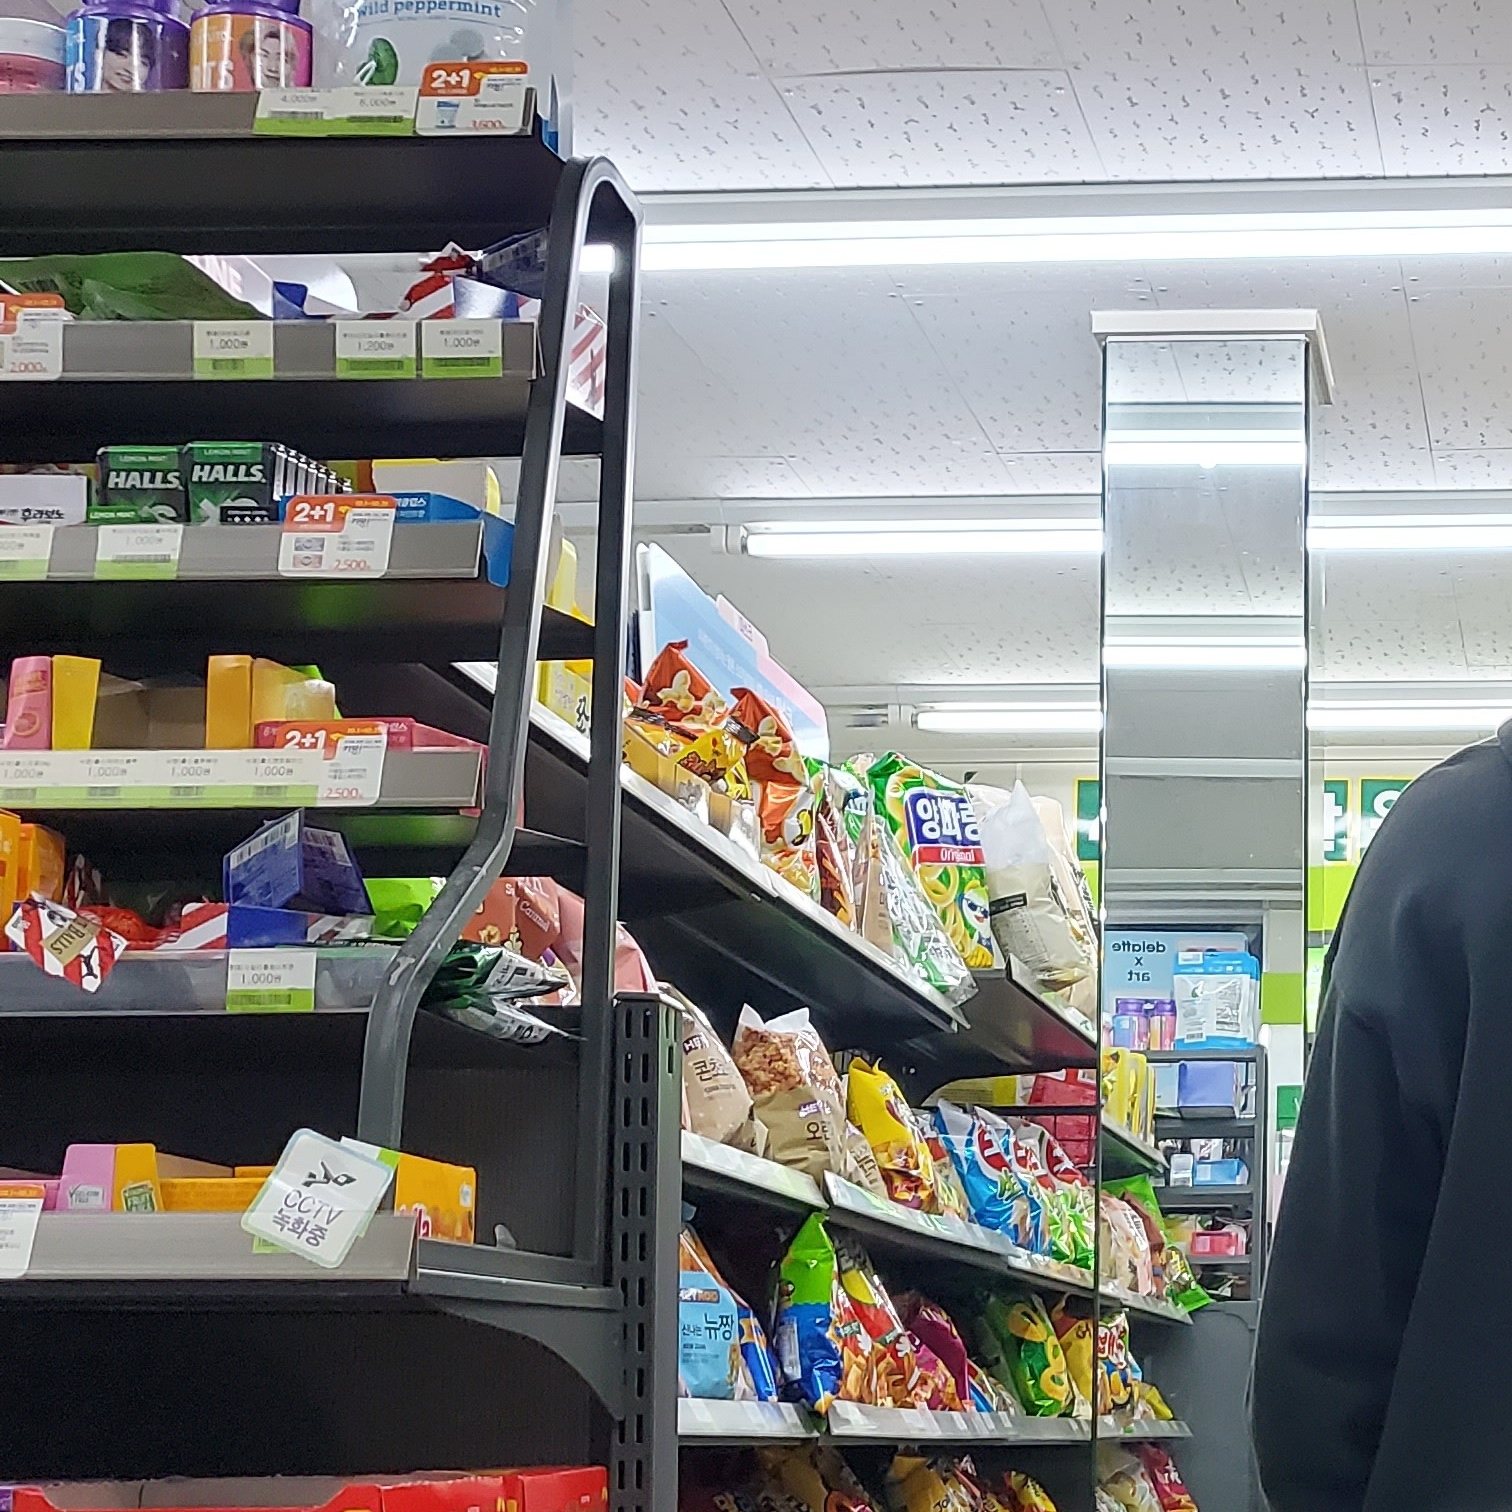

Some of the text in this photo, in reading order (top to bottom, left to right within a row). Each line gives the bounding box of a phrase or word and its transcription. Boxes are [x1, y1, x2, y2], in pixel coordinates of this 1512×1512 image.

[393, 0, 502, 18] peppermint
[431, 69, 470, 88] 2+1
[107, 471, 183, 491] HALLS
[191, 464, 267, 484] HALLS
[291, 502, 335, 523] 2+1
[284, 729, 327, 749] 2+1
[939, 846, 976, 863] Original
[283, 1189, 345, 1226] CCTV
[272, 1212, 327, 1248] 녹화중
